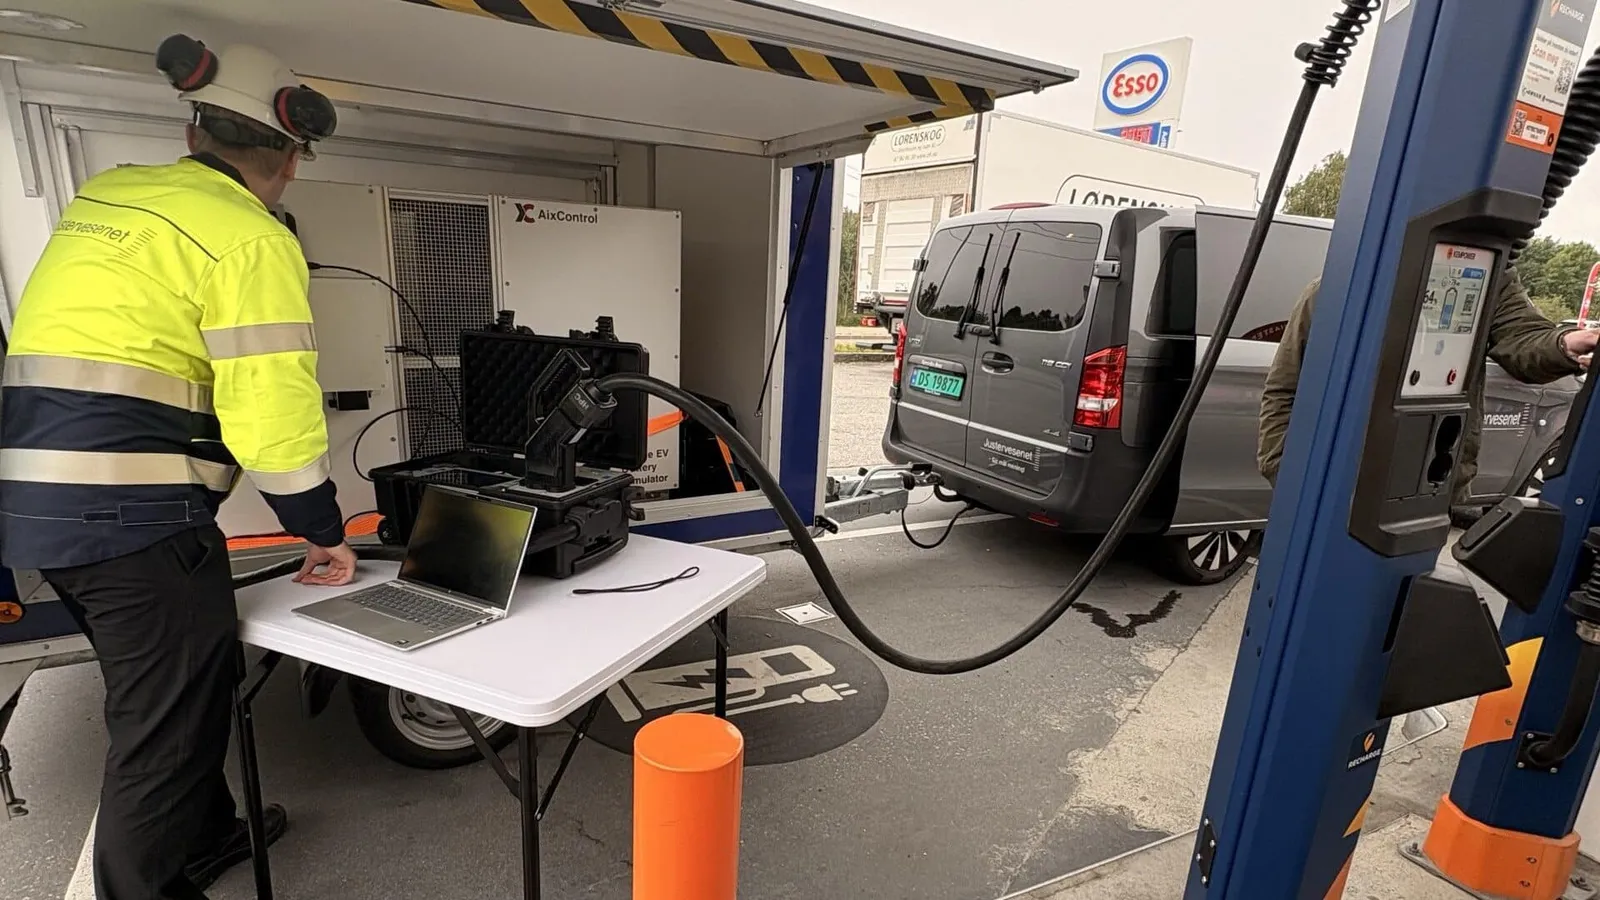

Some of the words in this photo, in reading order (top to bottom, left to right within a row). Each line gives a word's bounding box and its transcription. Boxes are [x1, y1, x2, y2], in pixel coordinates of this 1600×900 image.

[538, 209, 598, 224] AixControl
[918, 372, 930, 387] DS
[932, 375, 960, 393] 19877
[656, 449, 669, 458] EV
[983, 438, 1033, 461] Justervesenet
[632, 474, 668, 485] mulator
[1347, 748, 1381, 769] RECHARGE
